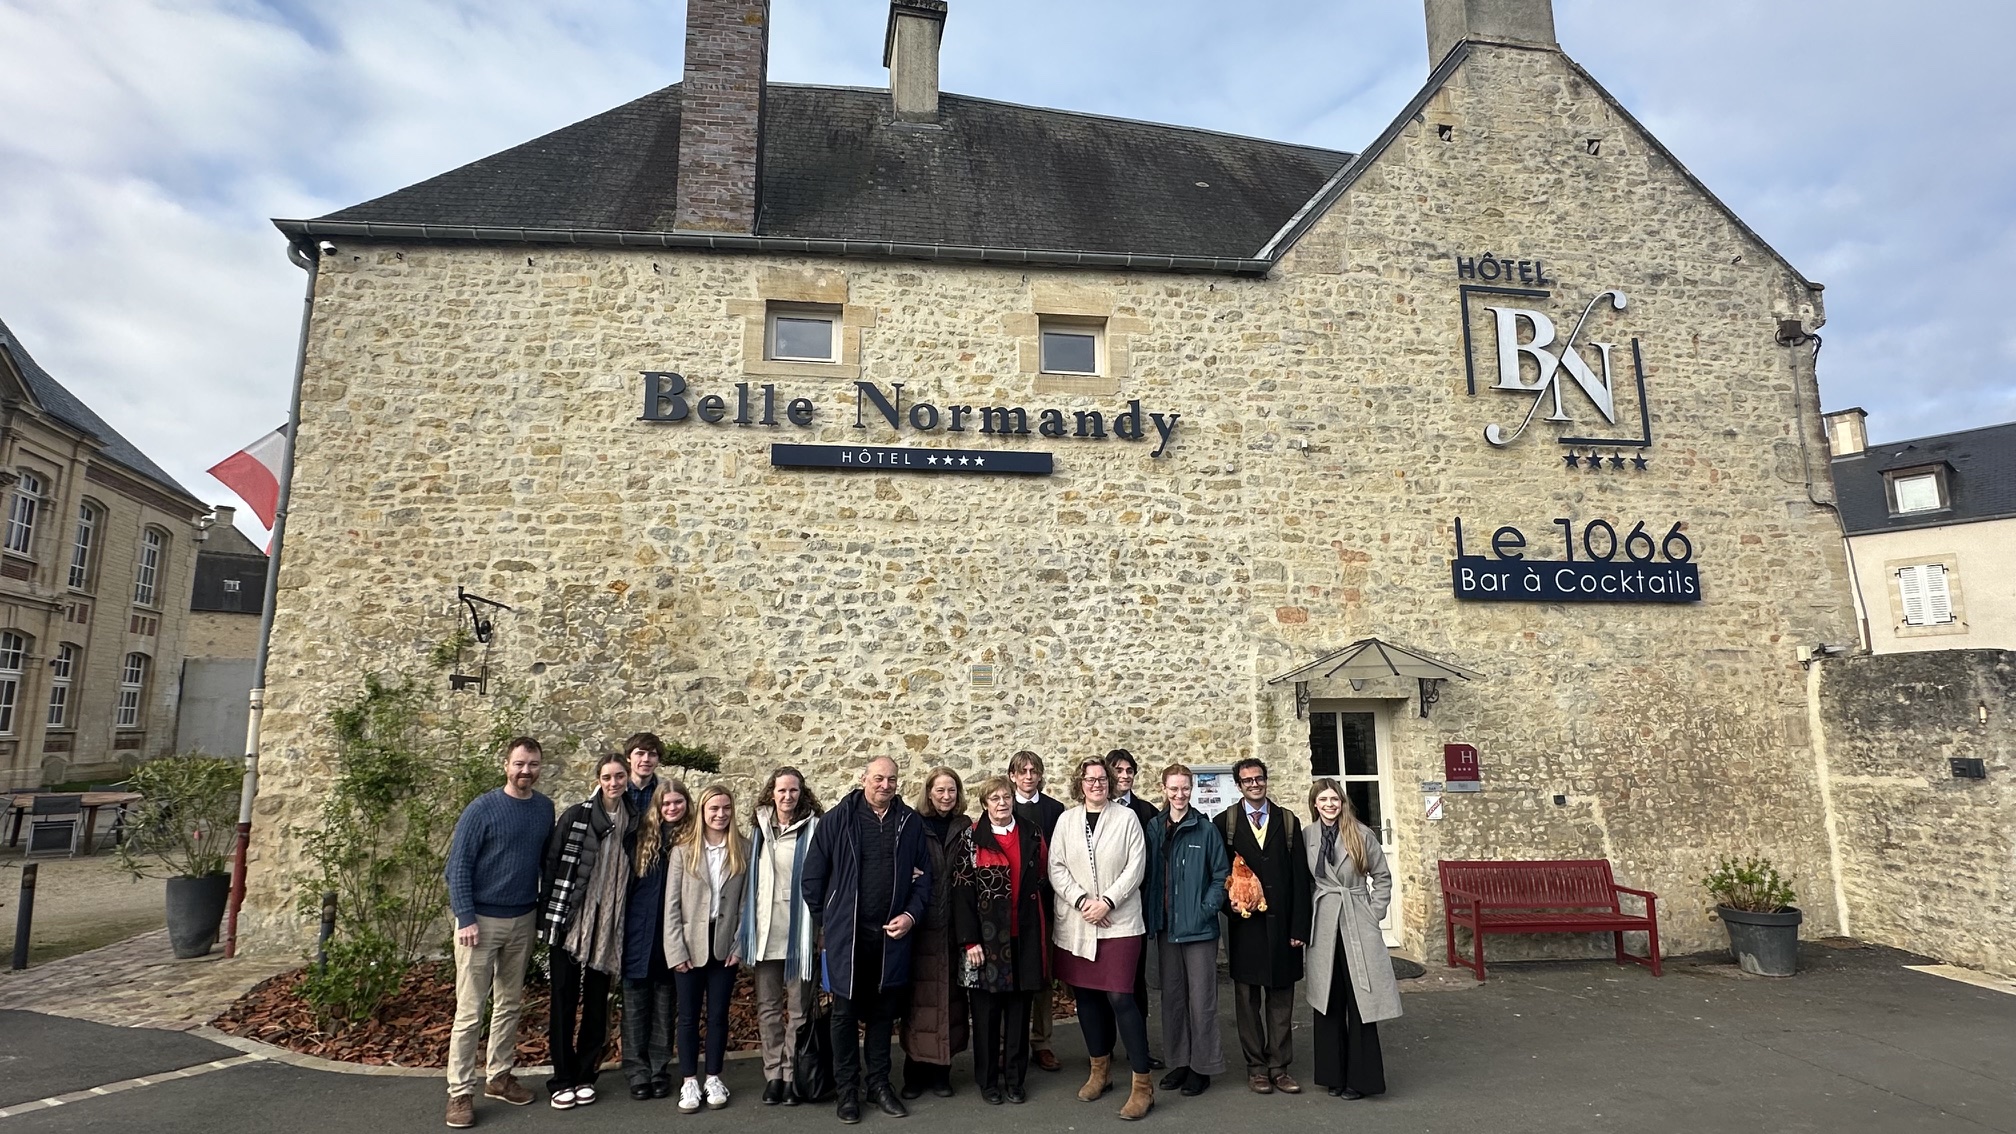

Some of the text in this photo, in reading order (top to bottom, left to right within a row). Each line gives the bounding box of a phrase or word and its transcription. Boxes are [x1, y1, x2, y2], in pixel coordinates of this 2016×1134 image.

[1457, 252, 1549, 285] HÔTEL
[637, 370, 1180, 458] Belle Normandy
[841, 448, 912, 466] HÔTEL
[1454, 516, 1692, 564] Le 1066
[1461, 566, 1695, 595] Bar à Cocktails
[1461, 750, 1473, 764] H
